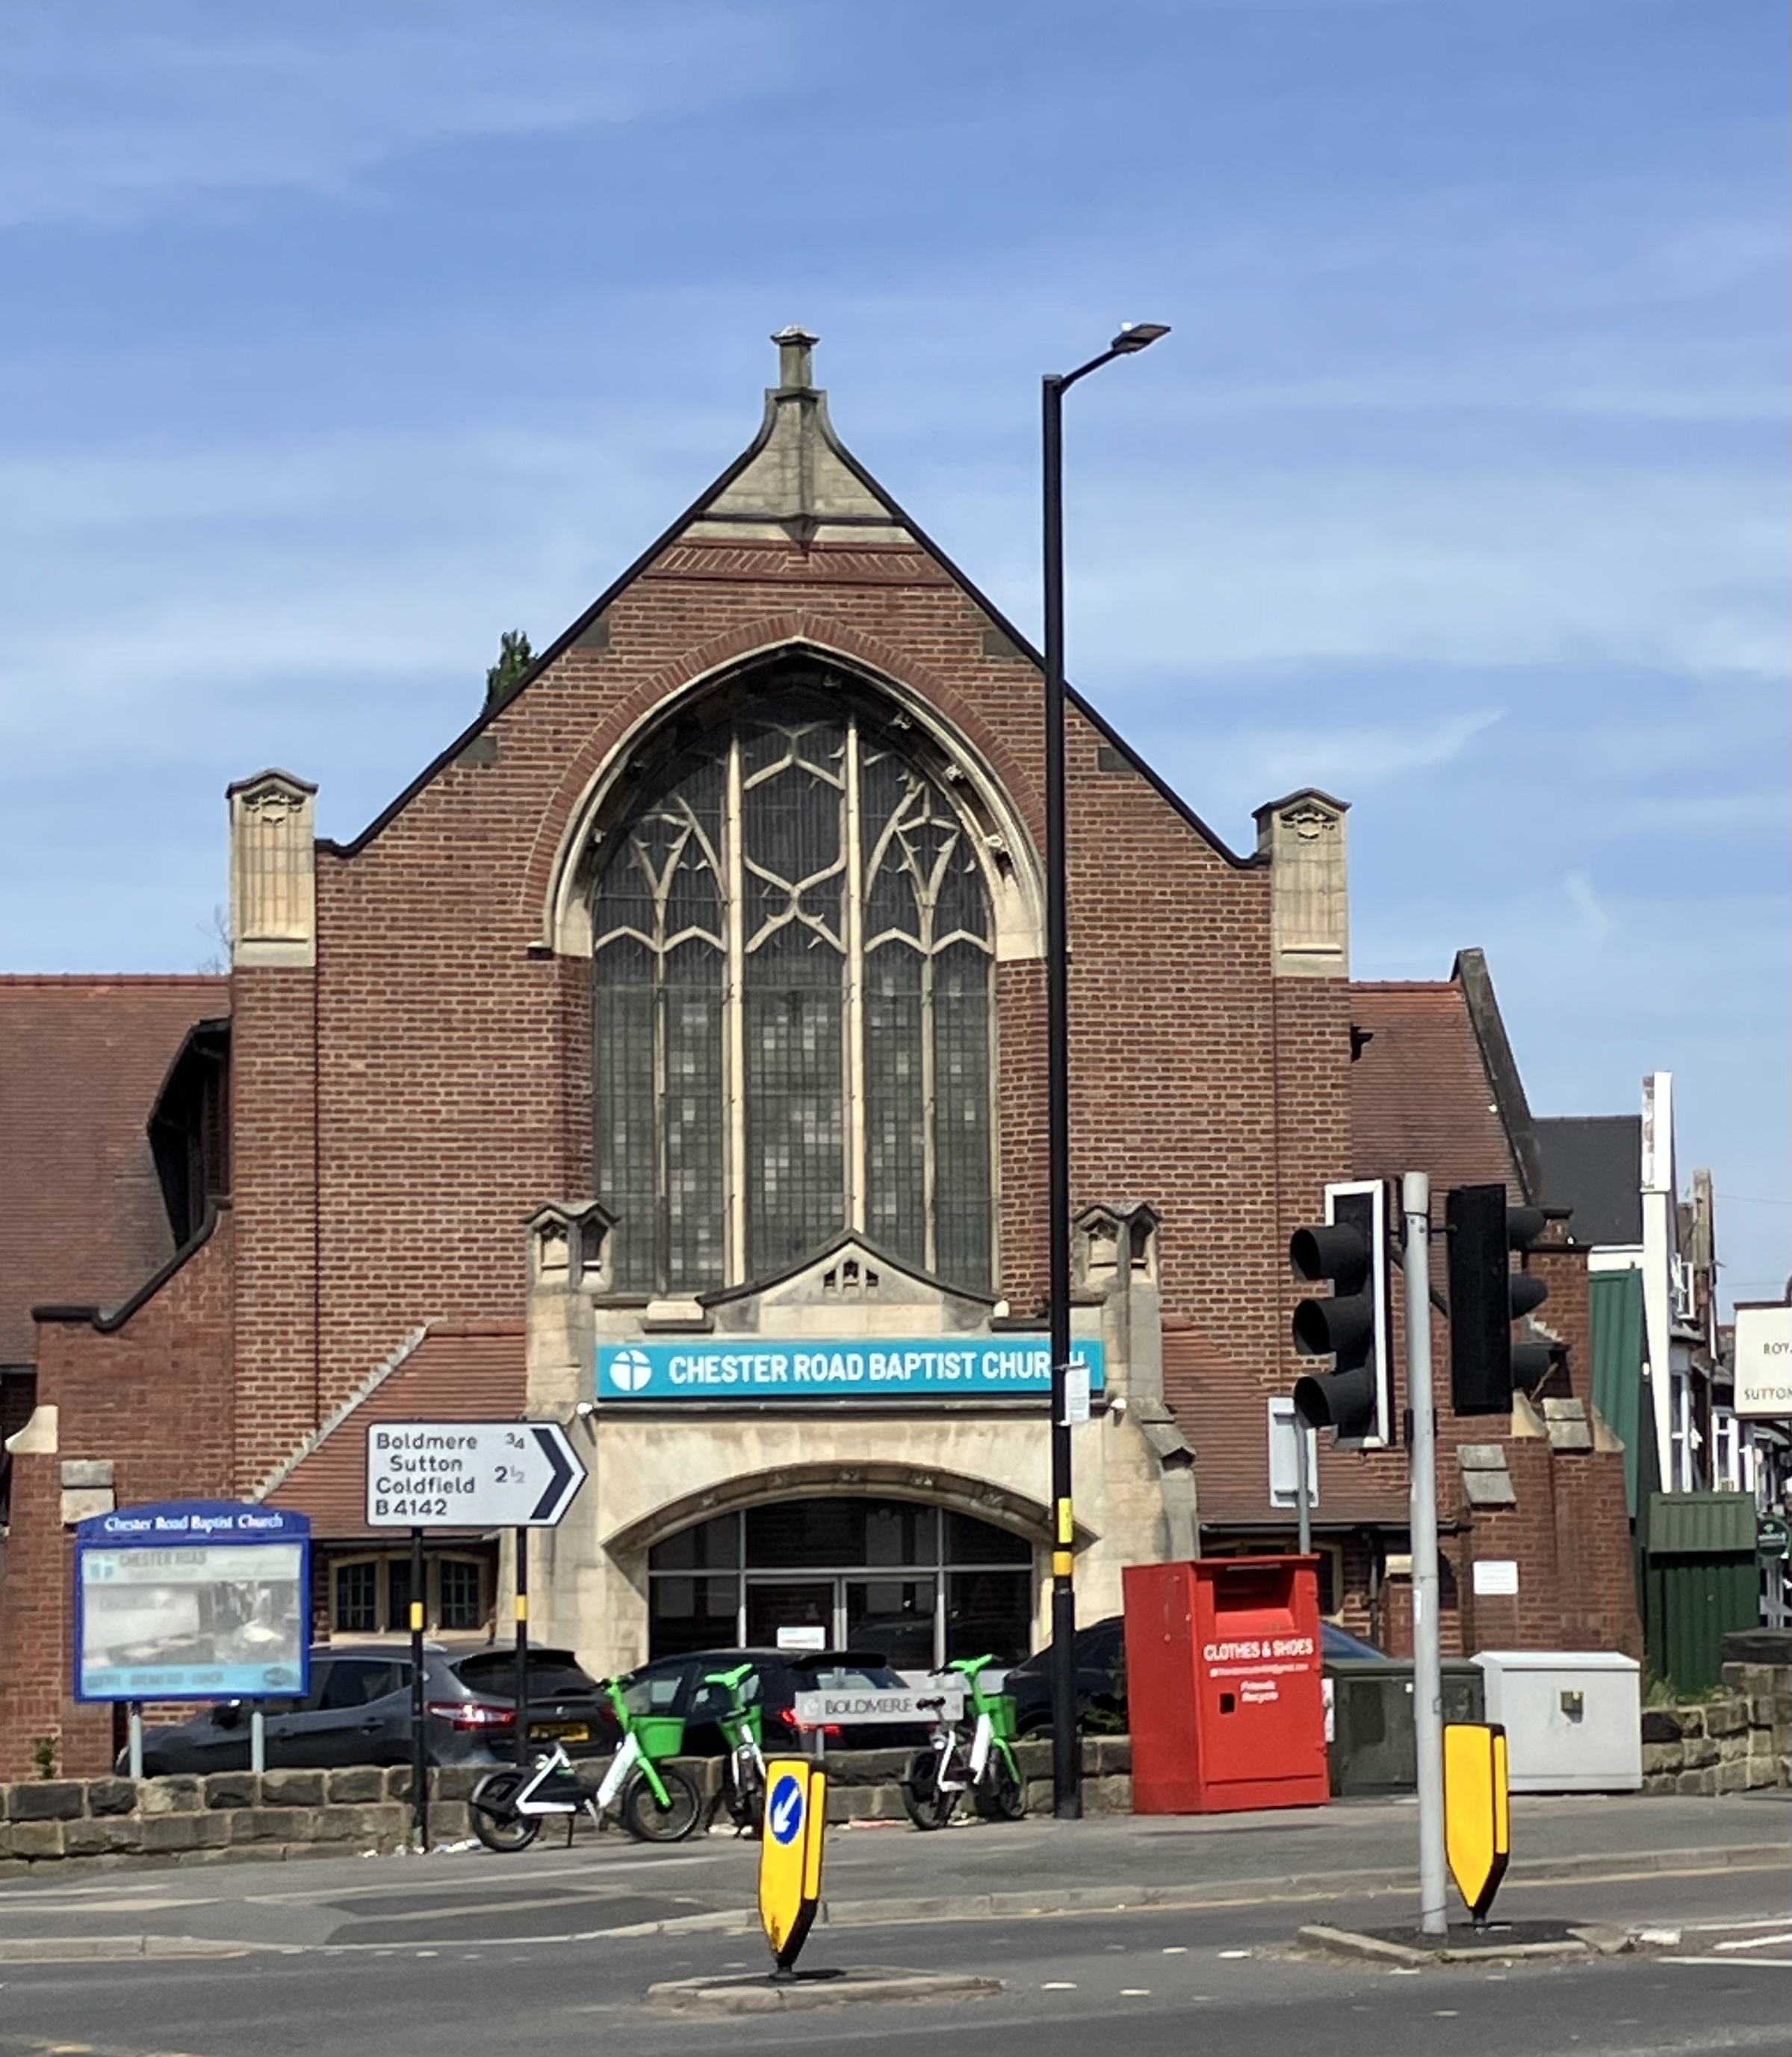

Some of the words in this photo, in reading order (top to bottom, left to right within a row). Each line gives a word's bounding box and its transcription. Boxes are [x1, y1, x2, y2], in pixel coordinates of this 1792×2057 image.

[1764, 1341, 1792, 1355] ROY
[669, 1354, 788, 1384] CHESTER
[793, 1353, 864, 1382] ROAD
[869, 1351, 976, 1381] BAPTIST
[982, 1350, 1085, 1379] CHURH
[376, 1433, 477, 1450] Boldmere
[390, 1455, 462, 1472] Sutton
[376, 1477, 475, 1494] Coldfield
[105, 1516, 152, 1531] Chester
[155, 1515, 188, 1530] Road
[191, 1515, 233, 1533] Baptist
[238, 1512, 283, 1529] Church
[1203, 1641, 1261, 1661] CLOTHES
[1262, 1641, 1271, 1657] &
[1272, 1638, 1314, 1657] SHOES
[825, 1698, 913, 1715] BOLDMERE
